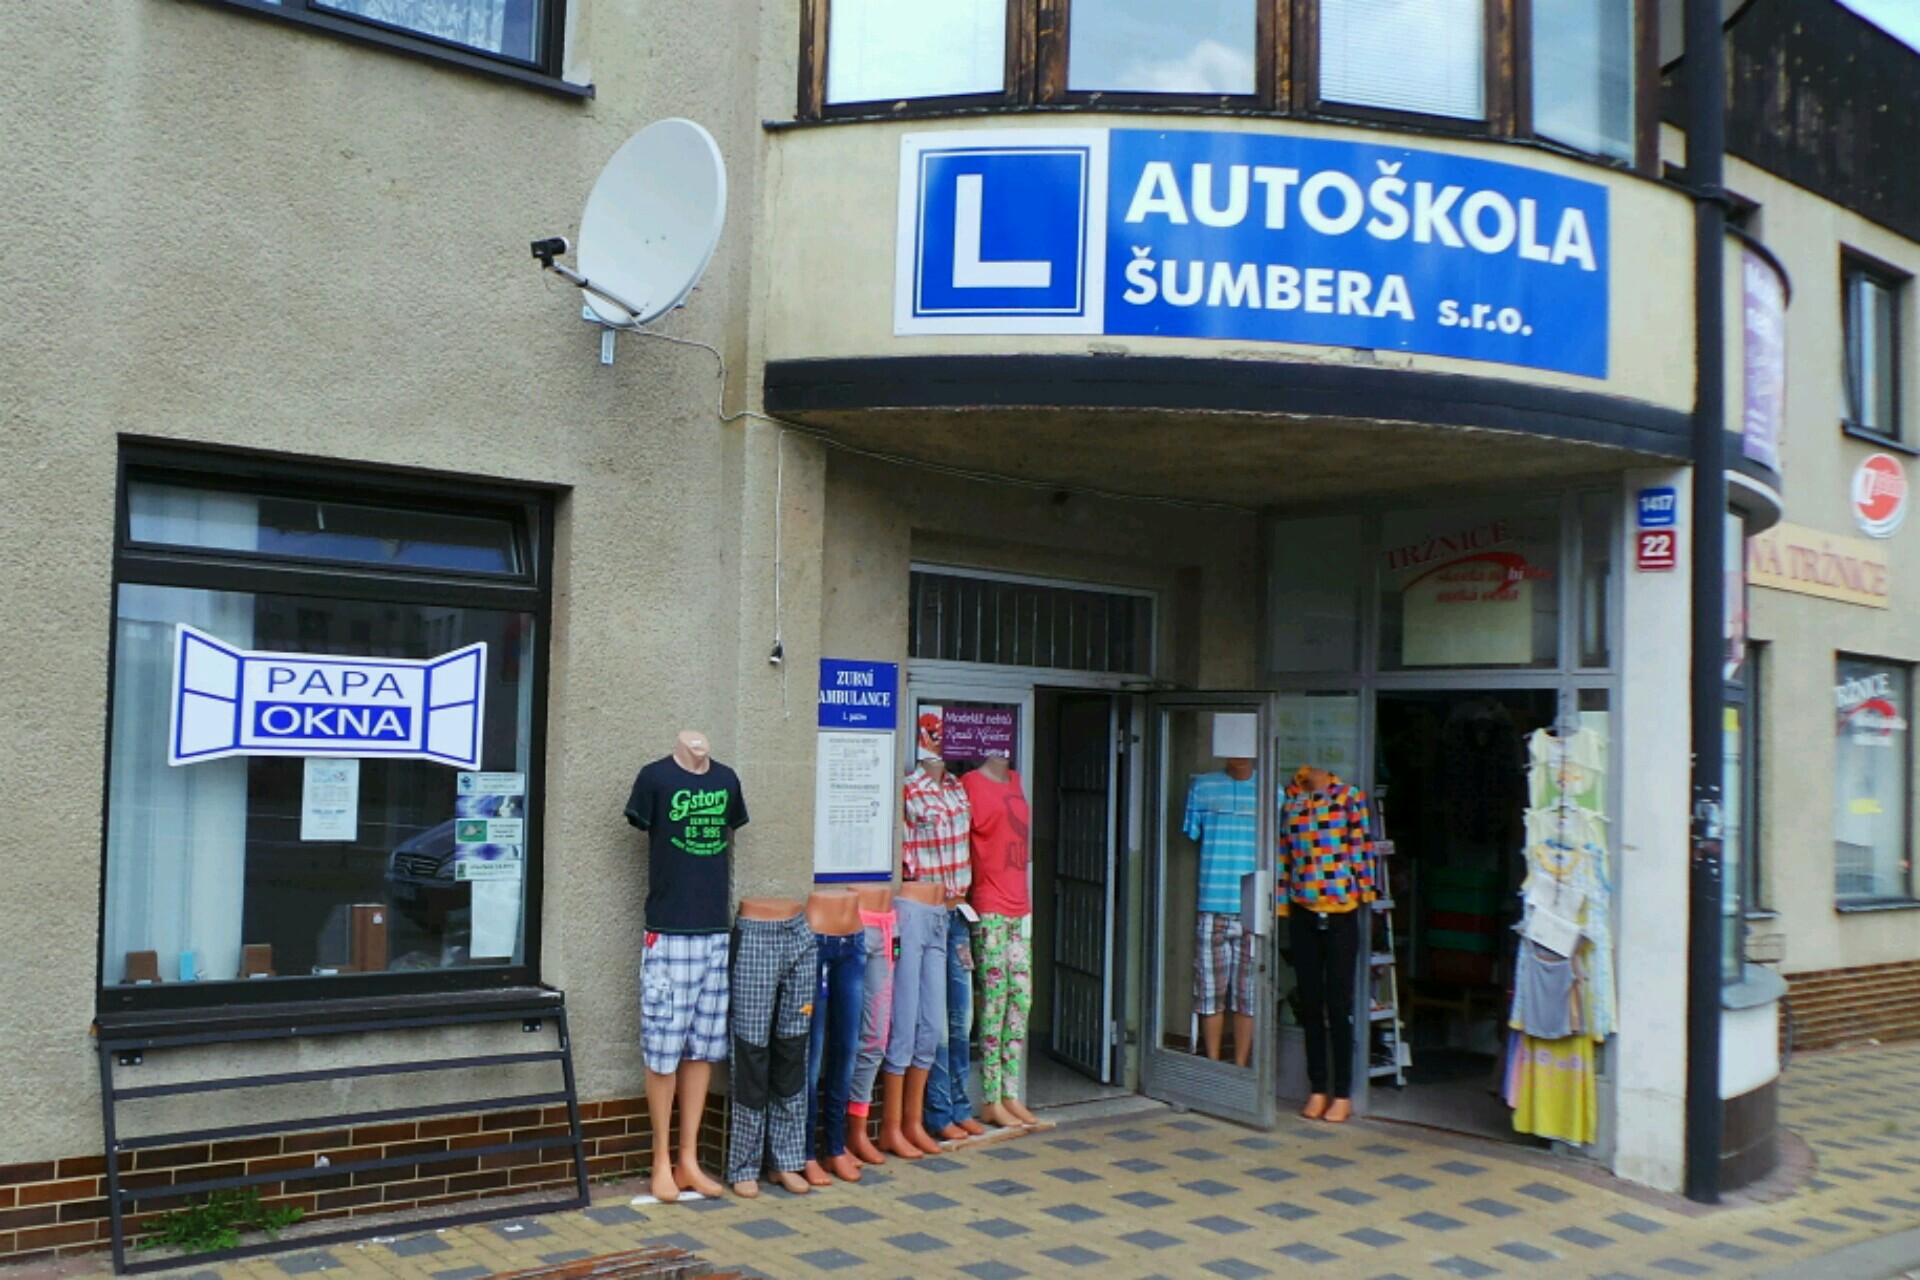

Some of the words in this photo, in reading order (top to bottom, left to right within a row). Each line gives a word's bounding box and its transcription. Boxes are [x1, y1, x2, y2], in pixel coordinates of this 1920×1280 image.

[952, 173, 1052, 289] L
[1124, 158, 1598, 272] AUTOŠKOLA
[1122, 245, 1416, 321] ŠUMBERA
[1437, 299, 1533, 336] s.r.o.
[1642, 534, 1671, 557] 22
[1788, 540, 1888, 598] TRŽNICE
[267, 667, 404, 699] PAPA
[836, 668, 875, 688] ZUBNÍ
[818, 689, 891, 708] AMBULANCE
[261, 705, 406, 737] OKNA
